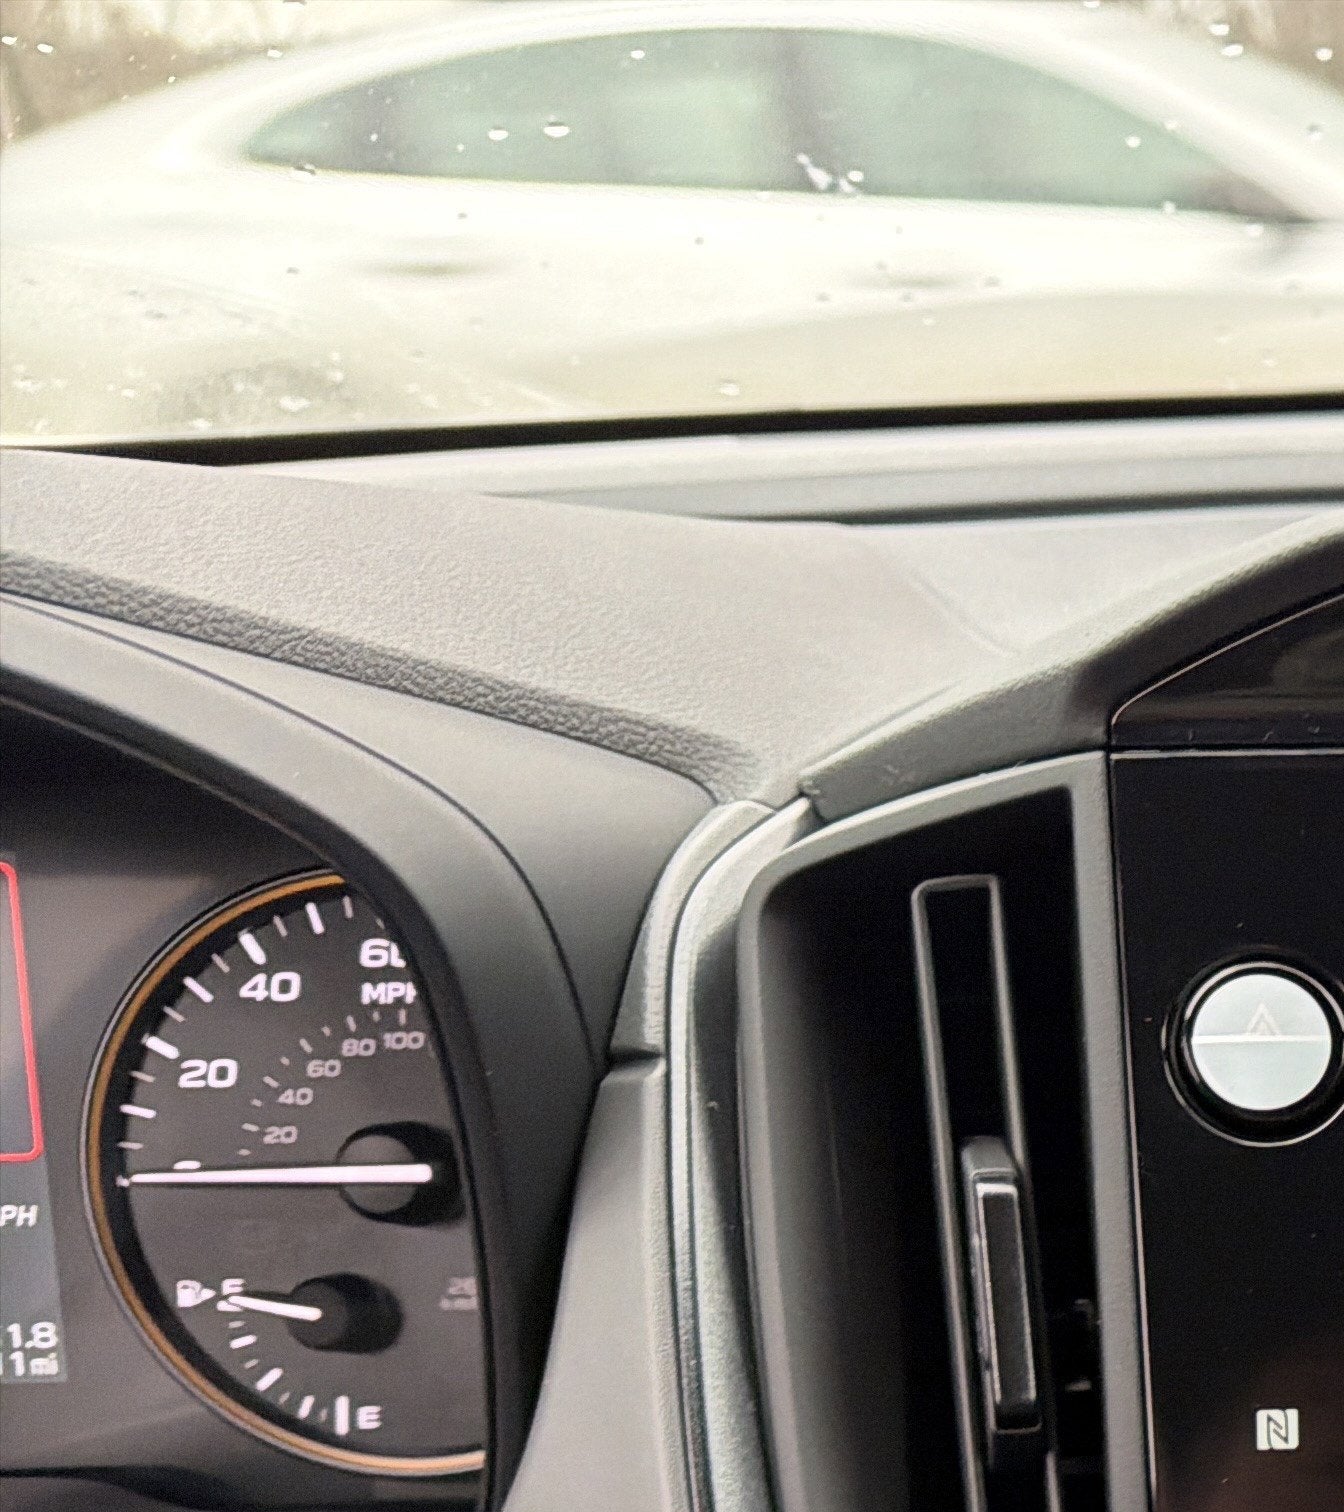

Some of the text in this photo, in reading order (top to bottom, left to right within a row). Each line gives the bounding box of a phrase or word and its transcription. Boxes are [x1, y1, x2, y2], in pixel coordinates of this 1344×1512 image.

[238, 971, 301, 1002] 40
[341, 1037, 377, 1057] 80
[382, 1030, 426, 1050] 100
[177, 1058, 238, 1089] 20
[306, 1058, 341, 1078] 60
[278, 1086, 314, 1106] 40
[262, 1125, 298, 1145] 20
[0, 1321, 58, 1349] 1.8
[355, 1405, 382, 1430] E
